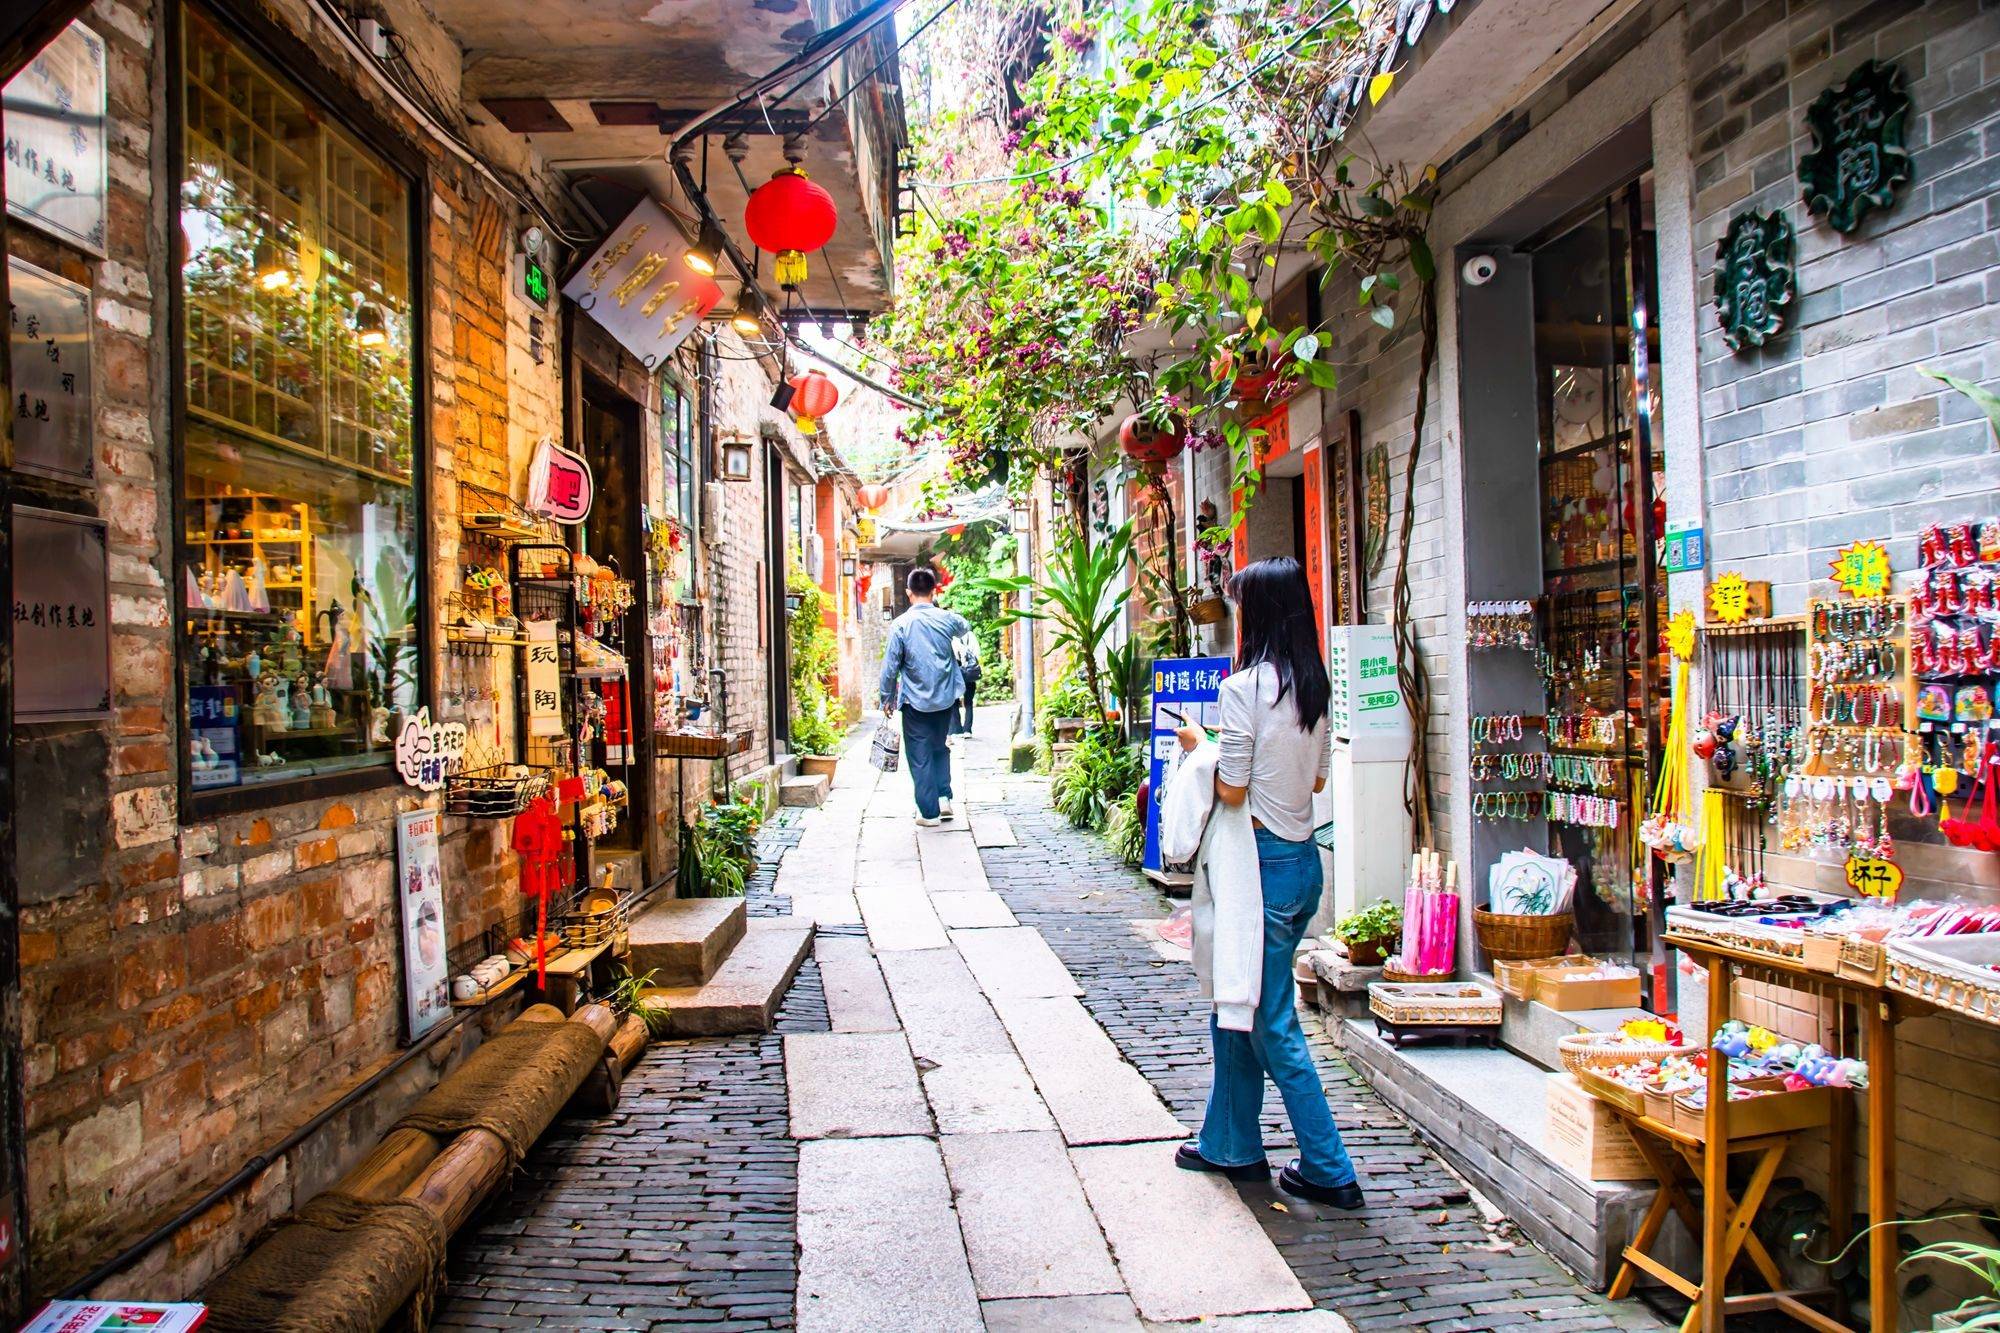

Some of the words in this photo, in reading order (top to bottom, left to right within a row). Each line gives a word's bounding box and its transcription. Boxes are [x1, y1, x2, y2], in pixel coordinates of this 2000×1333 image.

[1834, 88, 1885, 200] 玩陶
[1360, 656, 1388, 669] 用小电
[1360, 665, 1398, 679] 生活不断
[530, 646, 557, 711] 玩陶
[1368, 694, 1395, 706] 免押金
[1850, 860, 1891, 897] 杯子
